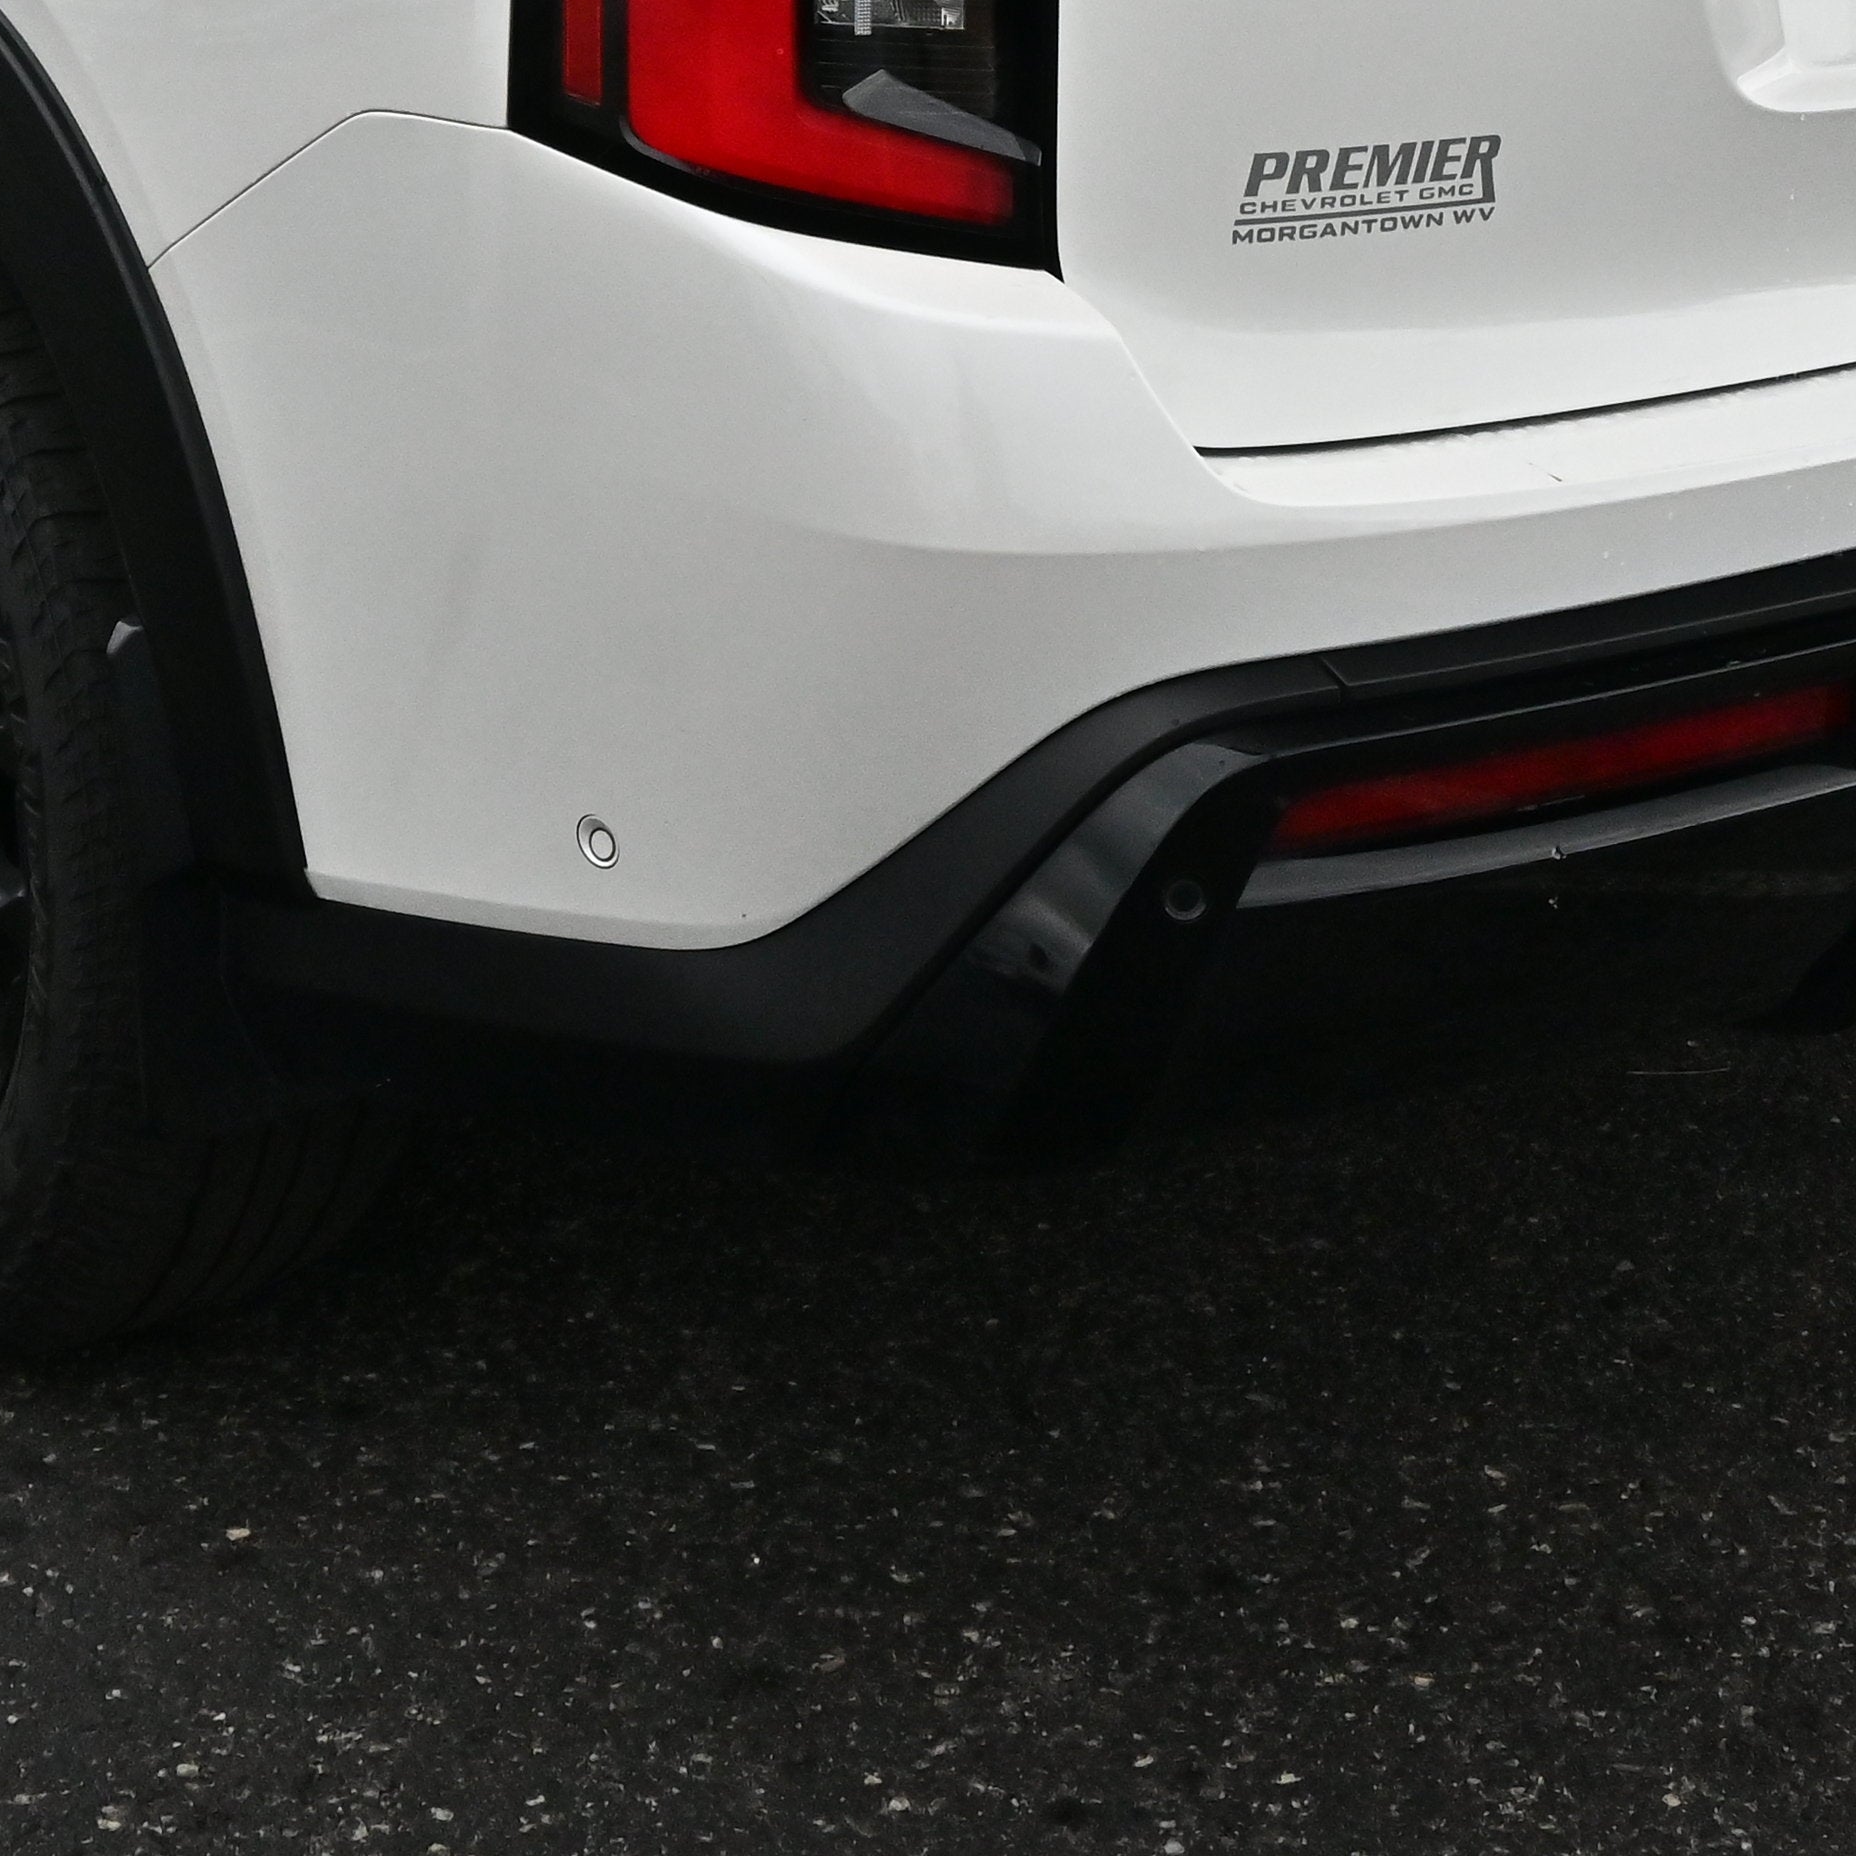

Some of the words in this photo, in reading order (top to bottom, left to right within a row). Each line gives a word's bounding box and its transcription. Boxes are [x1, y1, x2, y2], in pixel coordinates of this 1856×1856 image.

[1243, 134, 1502, 199] PREMIER
[1239, 190, 1410, 215] CHEVROLET
[1418, 183, 1474, 200] GMC
[1232, 212, 1444, 245] MORGANTOWN
[1453, 206, 1495, 225] WV
